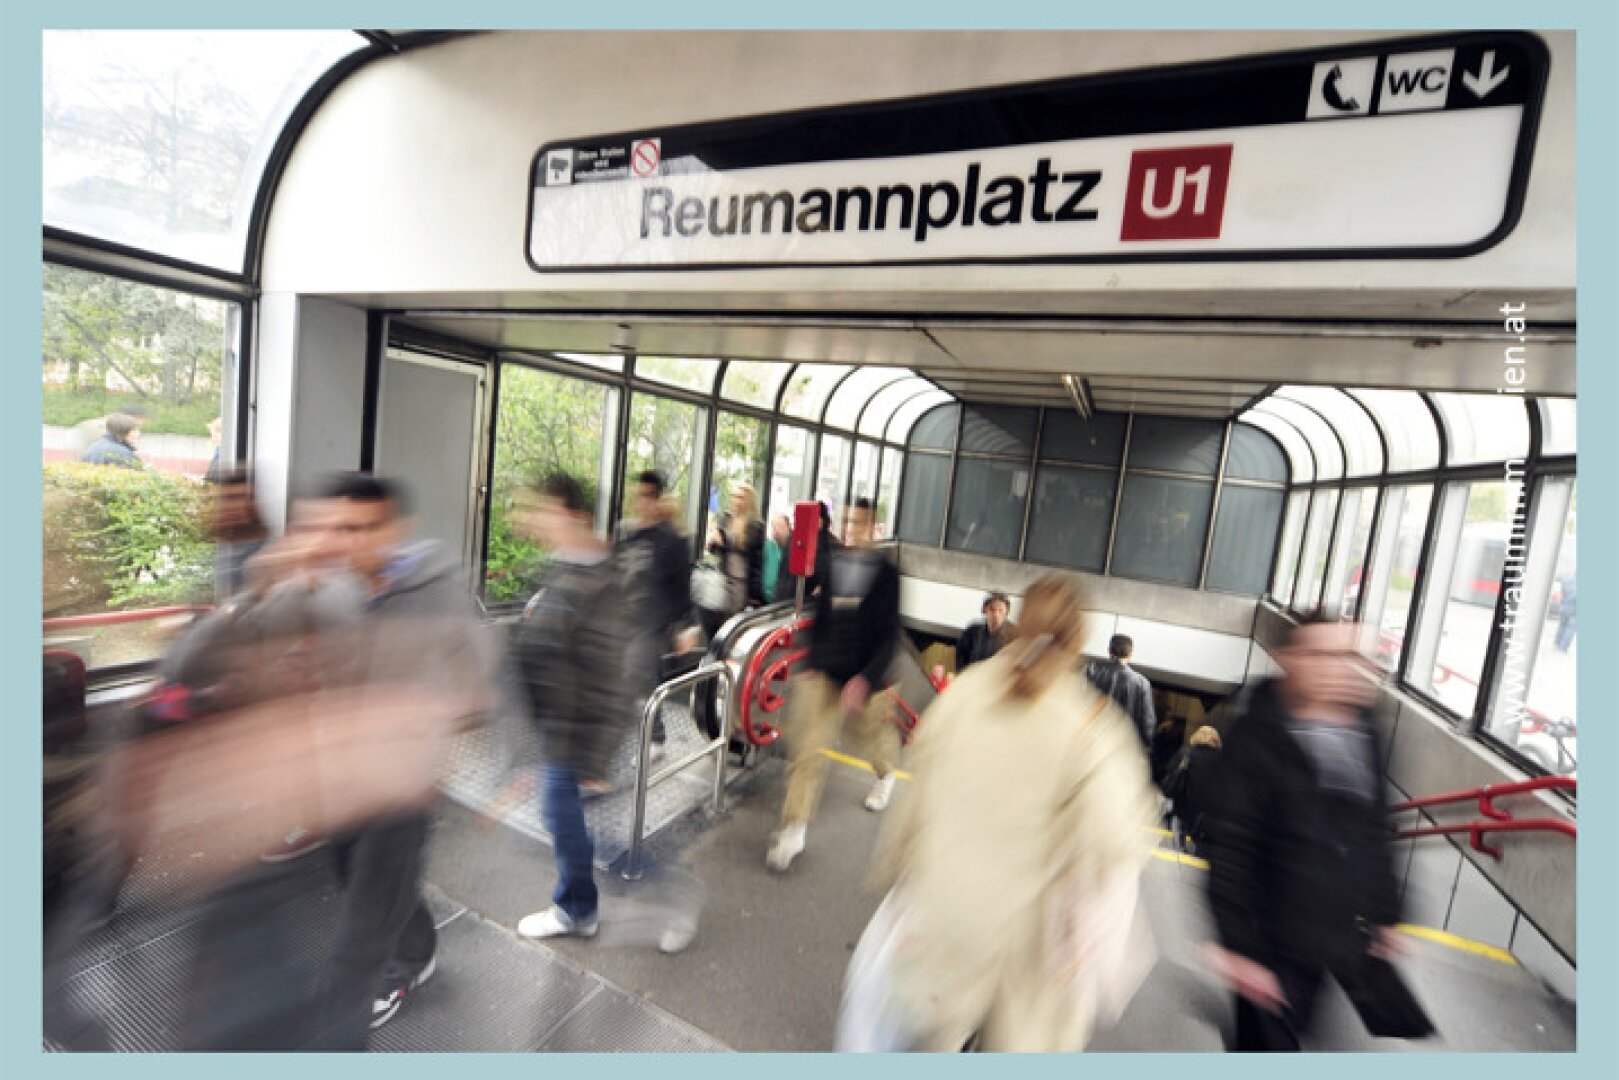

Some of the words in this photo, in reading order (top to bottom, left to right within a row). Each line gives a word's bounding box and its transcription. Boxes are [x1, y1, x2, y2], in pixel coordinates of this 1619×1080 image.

[1388, 66, 1446, 96] WC
[640, 158, 1102, 242] Reumannplatz
[1141, 165, 1211, 219] U1
